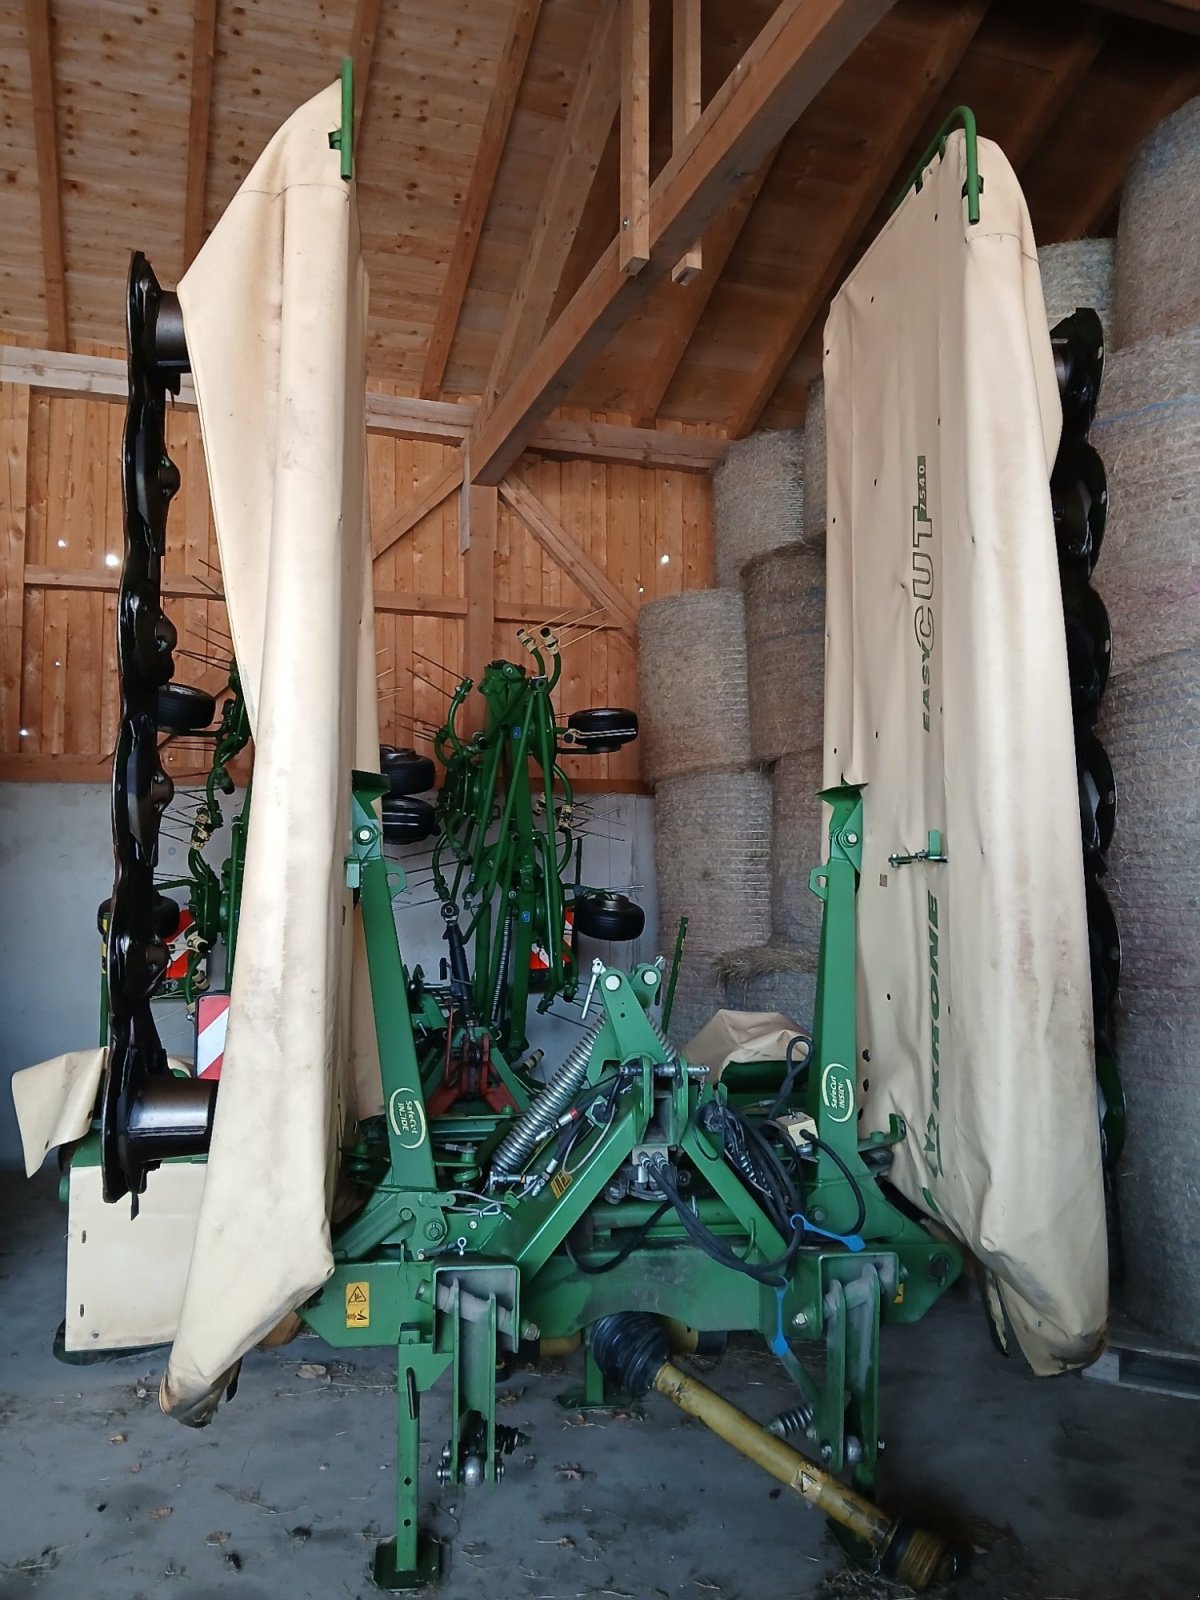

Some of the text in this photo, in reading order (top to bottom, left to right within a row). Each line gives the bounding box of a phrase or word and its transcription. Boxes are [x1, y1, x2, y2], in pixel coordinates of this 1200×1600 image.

[918, 465, 926, 512] 7540
[927, 890, 940, 1111] KRONE
[830, 1075, 838, 1109] SafeCut
[405, 1100, 418, 1134] SafeCut
